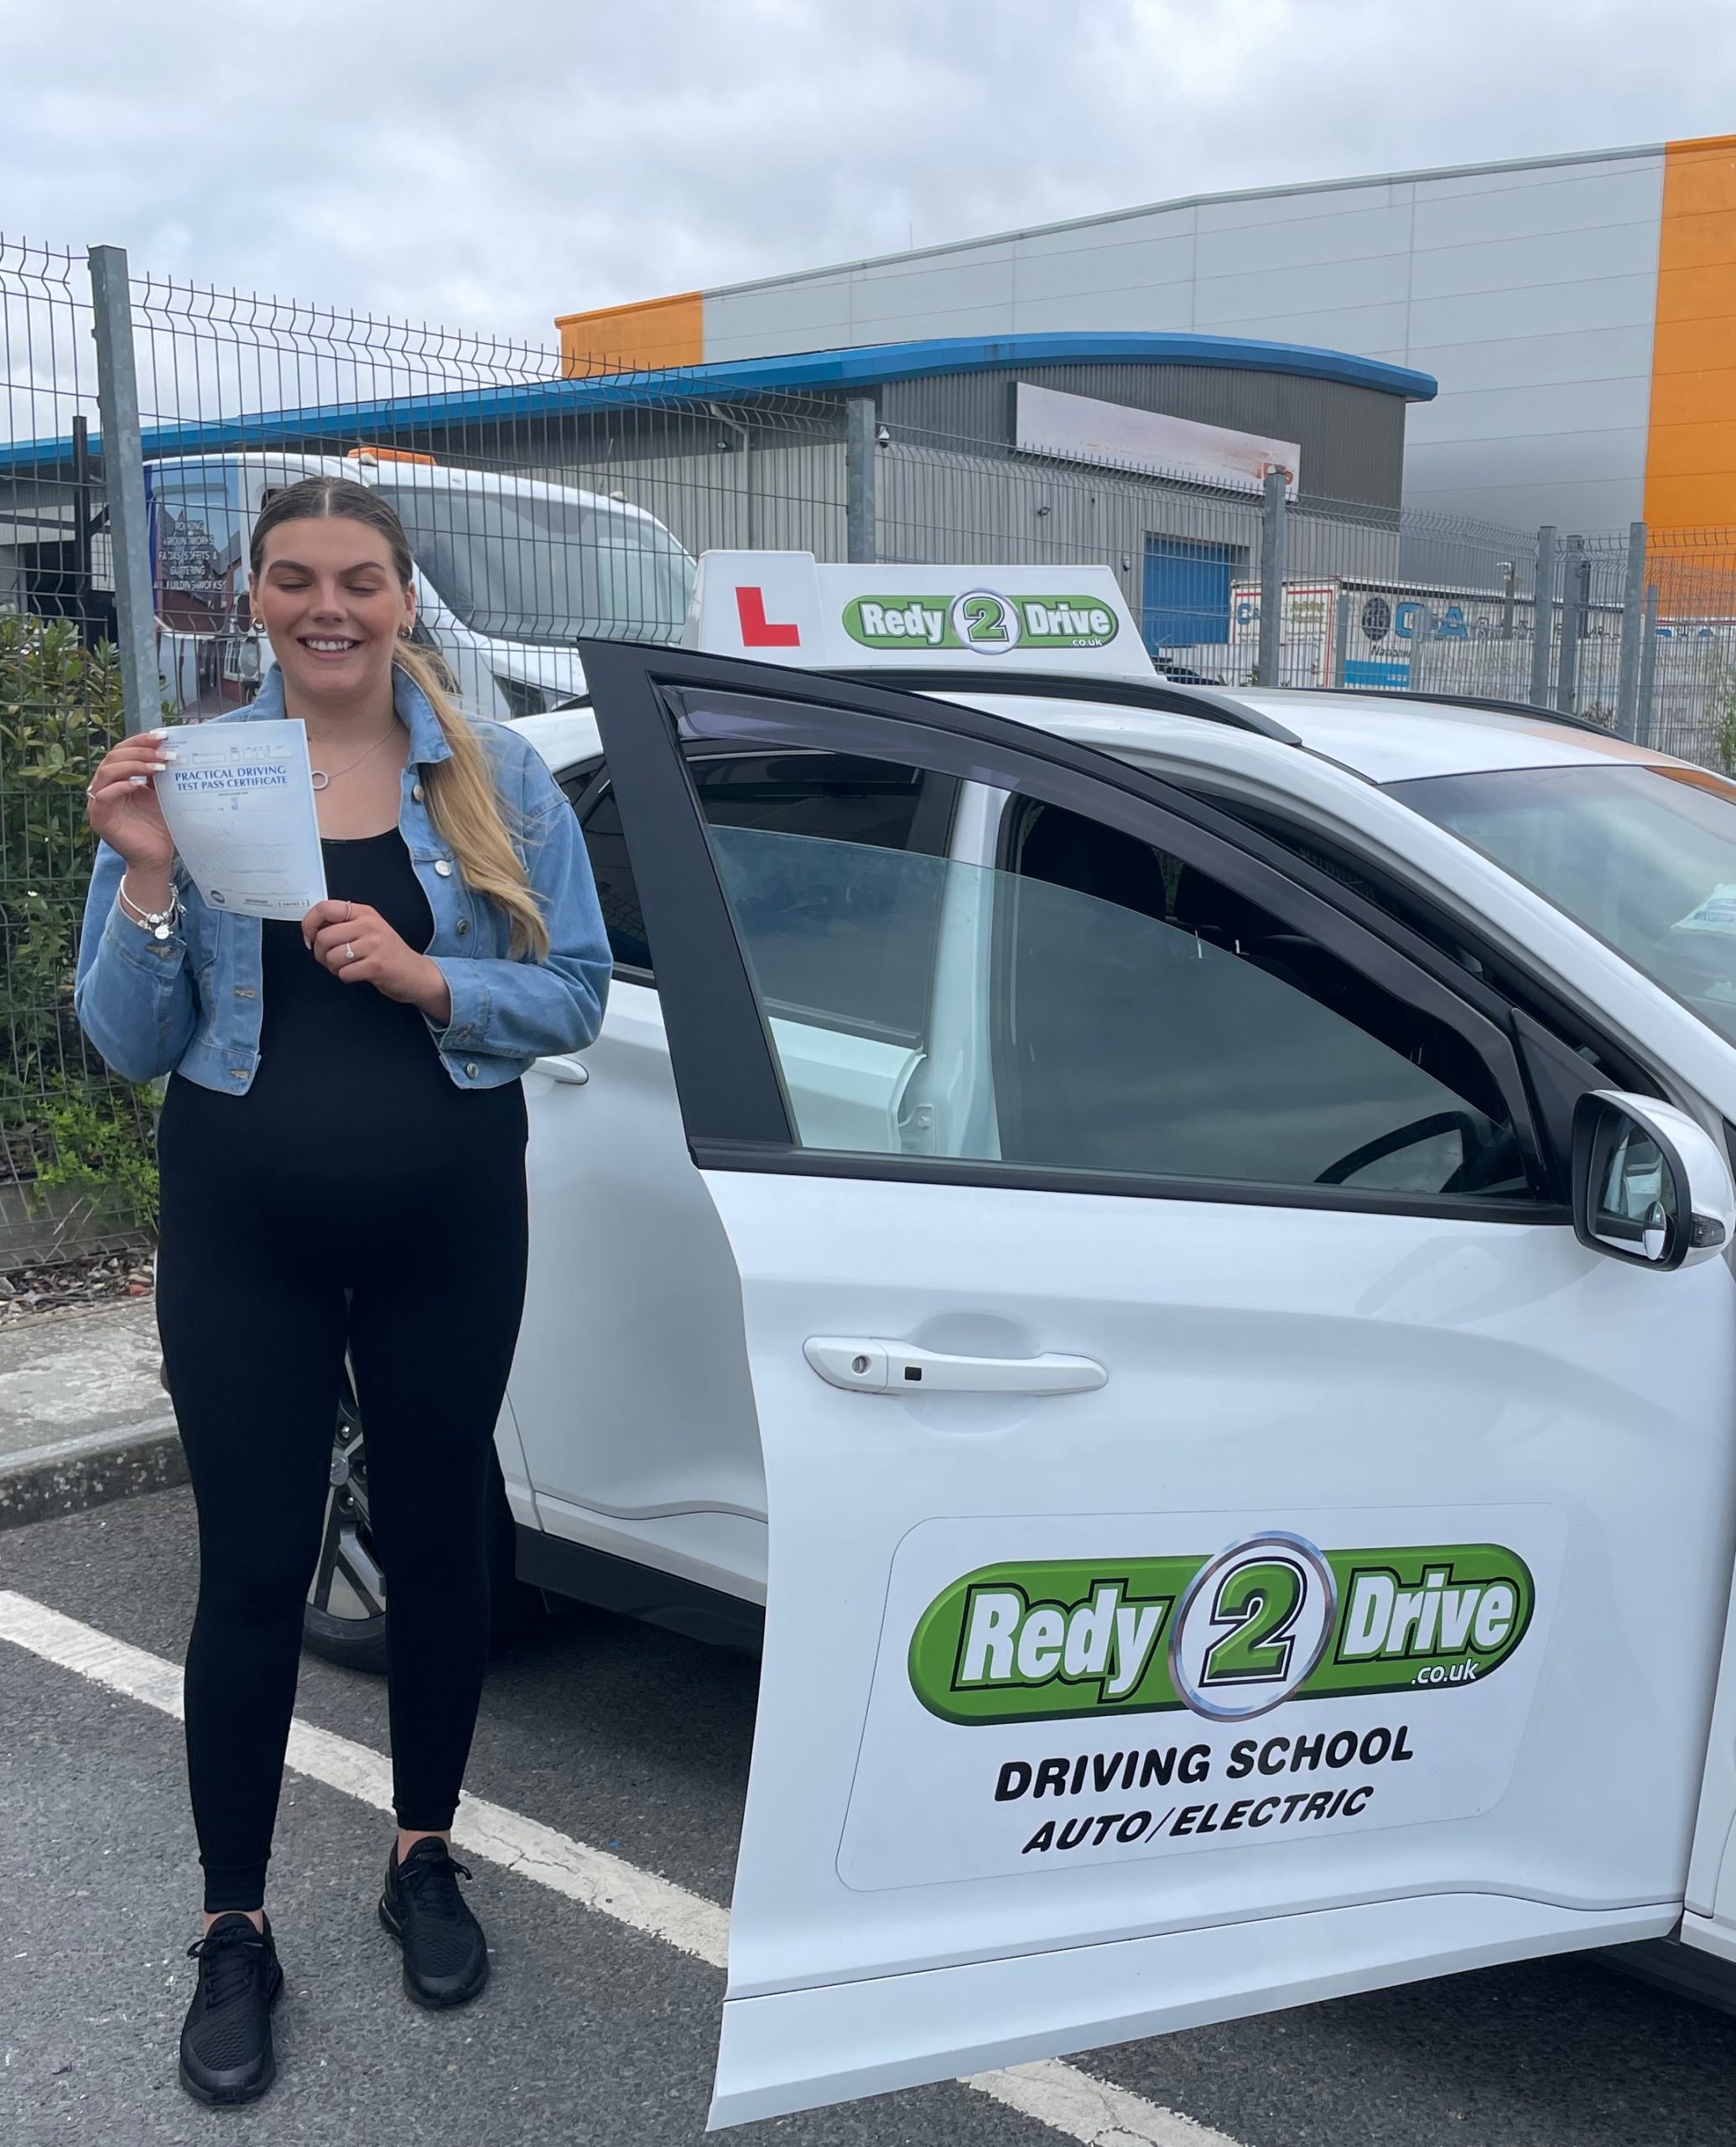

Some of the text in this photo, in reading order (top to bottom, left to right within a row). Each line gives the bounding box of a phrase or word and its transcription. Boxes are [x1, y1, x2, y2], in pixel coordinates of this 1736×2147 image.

[735, 585, 801, 647] L
[859, 596, 1110, 644] Redy 2 Drive
[174, 765, 286, 782] PRACTICAL DRIVING
[176, 776, 288, 792] TEST PASS CERTIFICATE
[956, 1557, 1515, 1700] Redy 2 Drive
[1410, 1658, 1482, 1687] .co.uk
[994, 1725, 1414, 1802] DRIVING SCHOOL
[1021, 1786, 1375, 1855] AUTO/ELECTRIC
